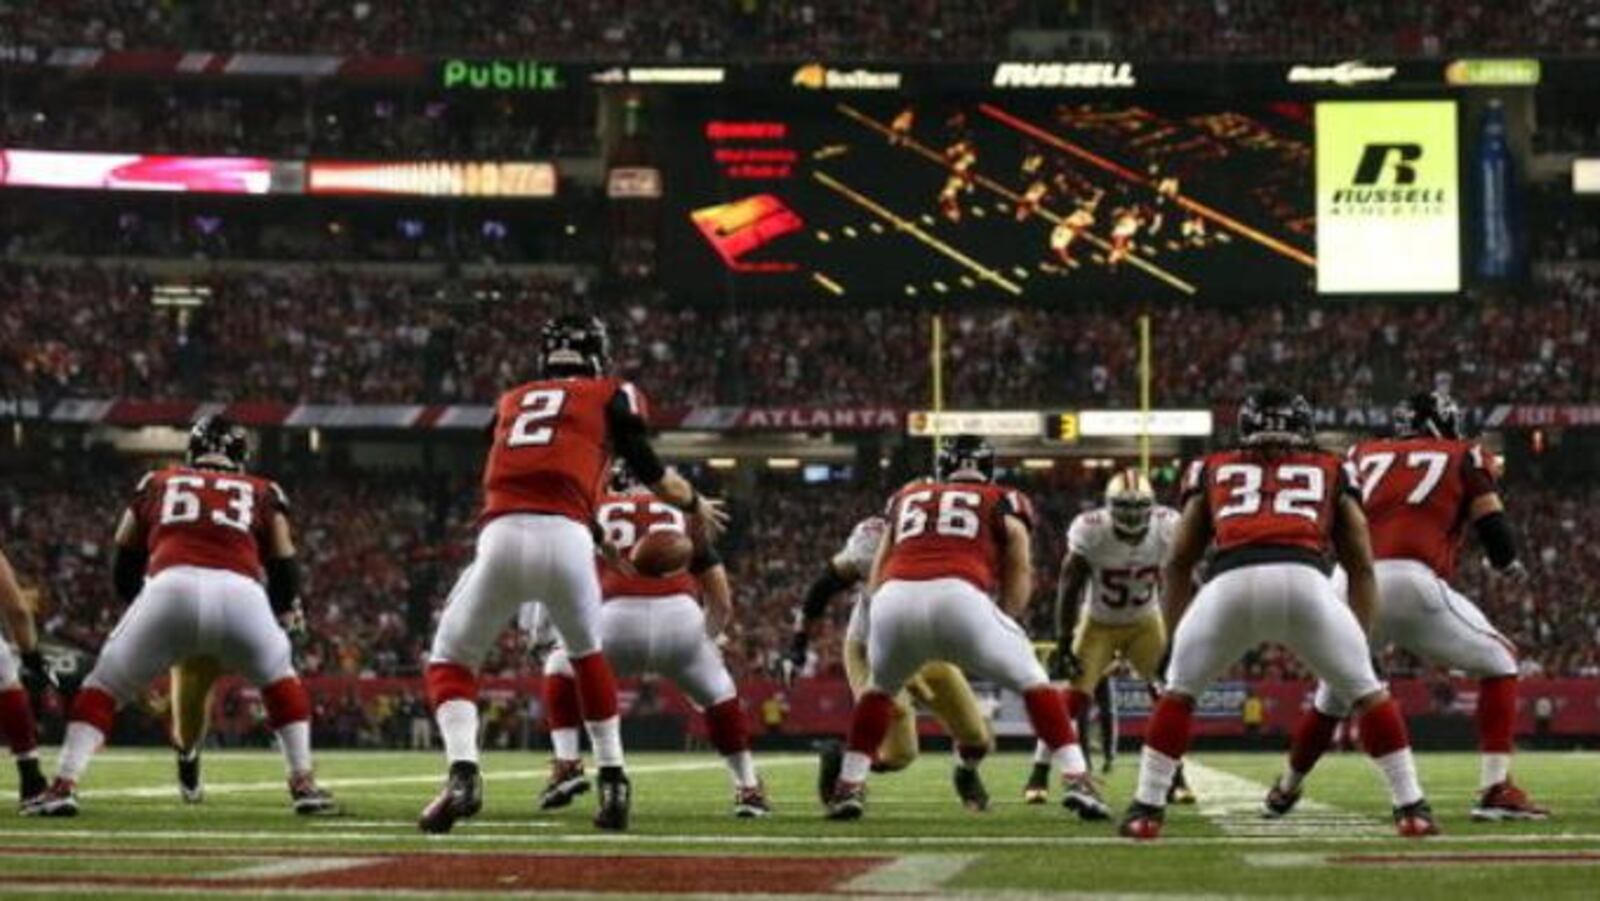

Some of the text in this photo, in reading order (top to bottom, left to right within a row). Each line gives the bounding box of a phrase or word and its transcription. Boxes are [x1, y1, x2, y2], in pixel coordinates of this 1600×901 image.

[444, 61, 557, 88] Publix
[993, 62, 1135, 86] RUSSELL
[1332, 189, 1444, 203] RUSSELL
[508, 390, 566, 447] 2
[750, 409, 897, 426] ATLANTA
[1216, 464, 1325, 520] 32
[1359, 452, 1448, 503] 77
[161, 477, 254, 533] 63
[896, 490, 981, 543] 66
[1101, 566, 1162, 609] 53
